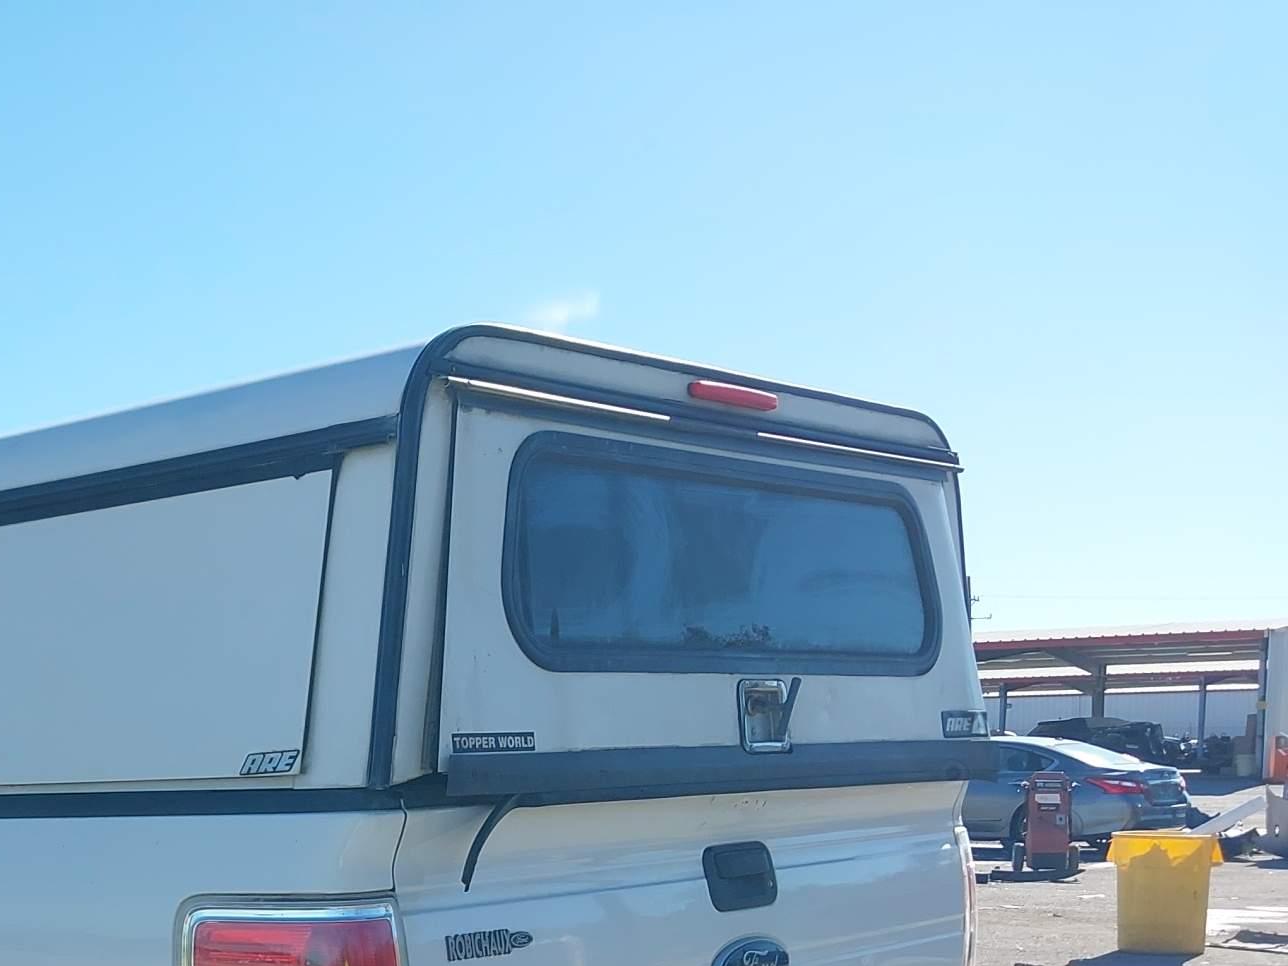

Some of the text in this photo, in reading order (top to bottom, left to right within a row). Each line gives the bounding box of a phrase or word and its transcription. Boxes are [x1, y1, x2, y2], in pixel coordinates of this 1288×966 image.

[453, 735, 534, 749] TOPPER WORLD
[240, 750, 300, 775] ARE
[445, 929, 512, 961] ROBICHAUX
